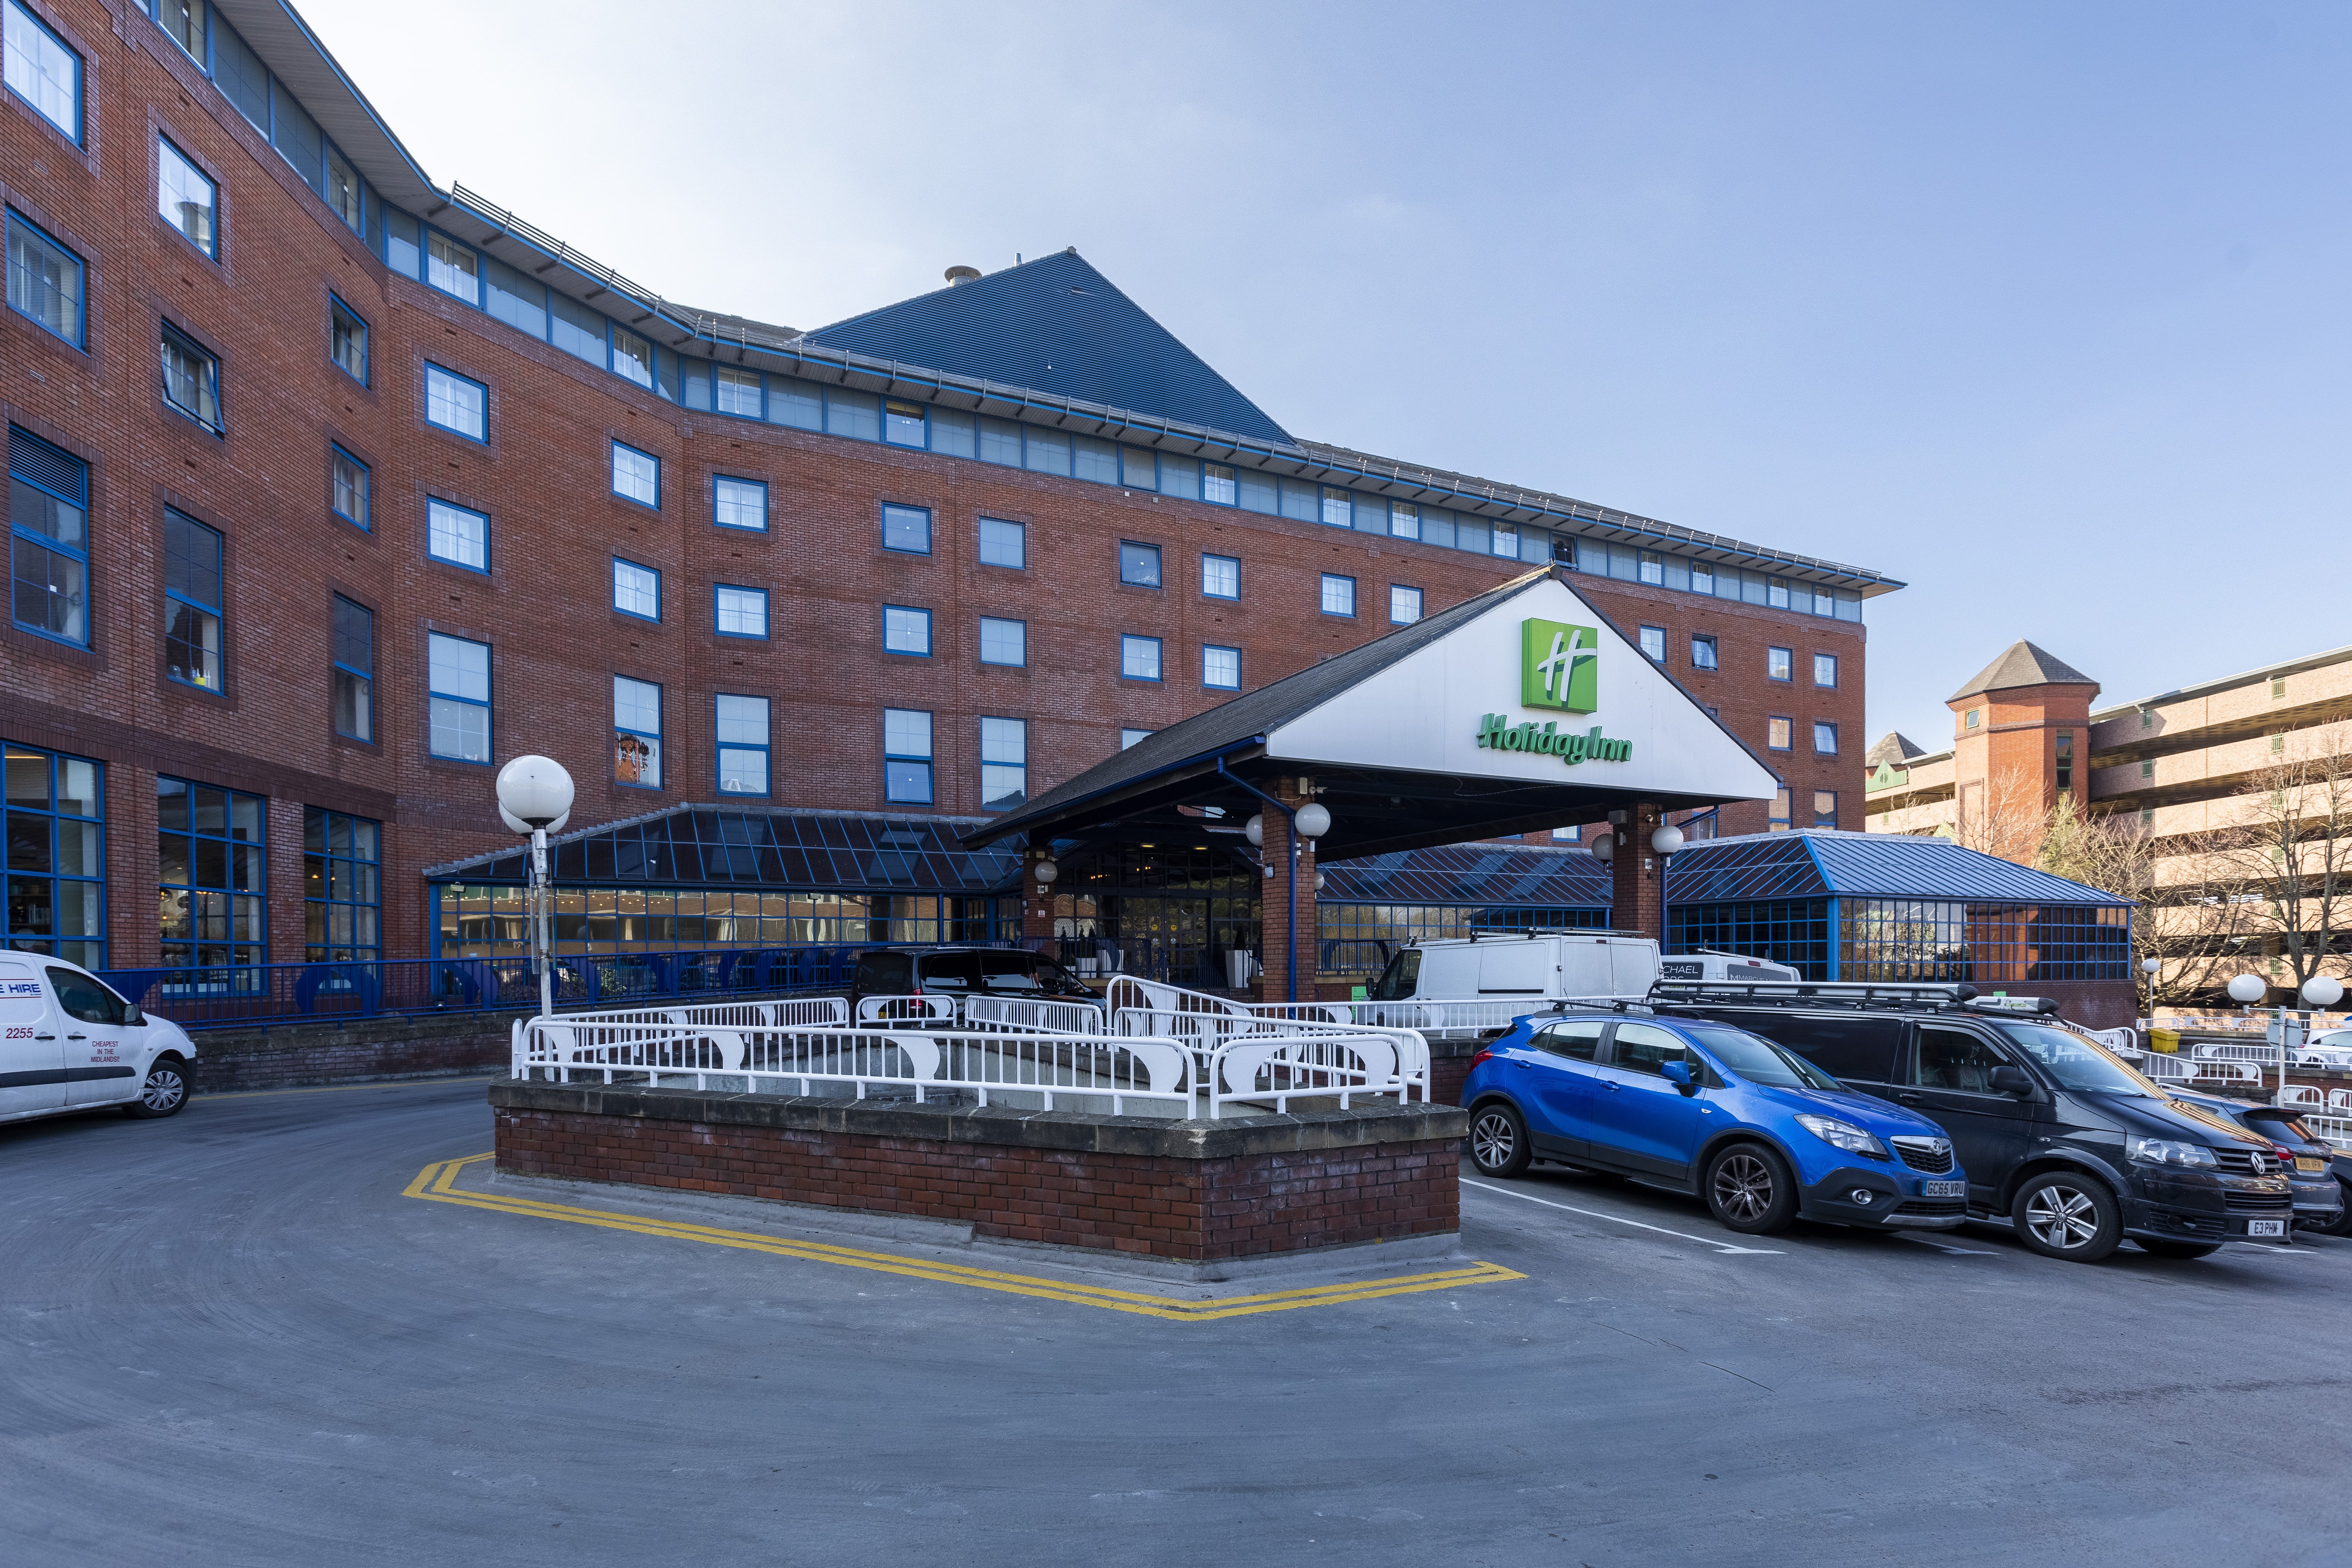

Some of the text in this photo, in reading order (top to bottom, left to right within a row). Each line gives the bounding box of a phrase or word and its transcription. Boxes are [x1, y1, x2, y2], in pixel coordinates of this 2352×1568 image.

[1476, 713, 1633, 765] Holiday Inn
[8, 984, 41, 993] HIRE
[6, 1027, 33, 1038] 2255
[1927, 1182, 1964, 1194] GC65 VRU
[2254, 1222, 2263, 1234] E3
